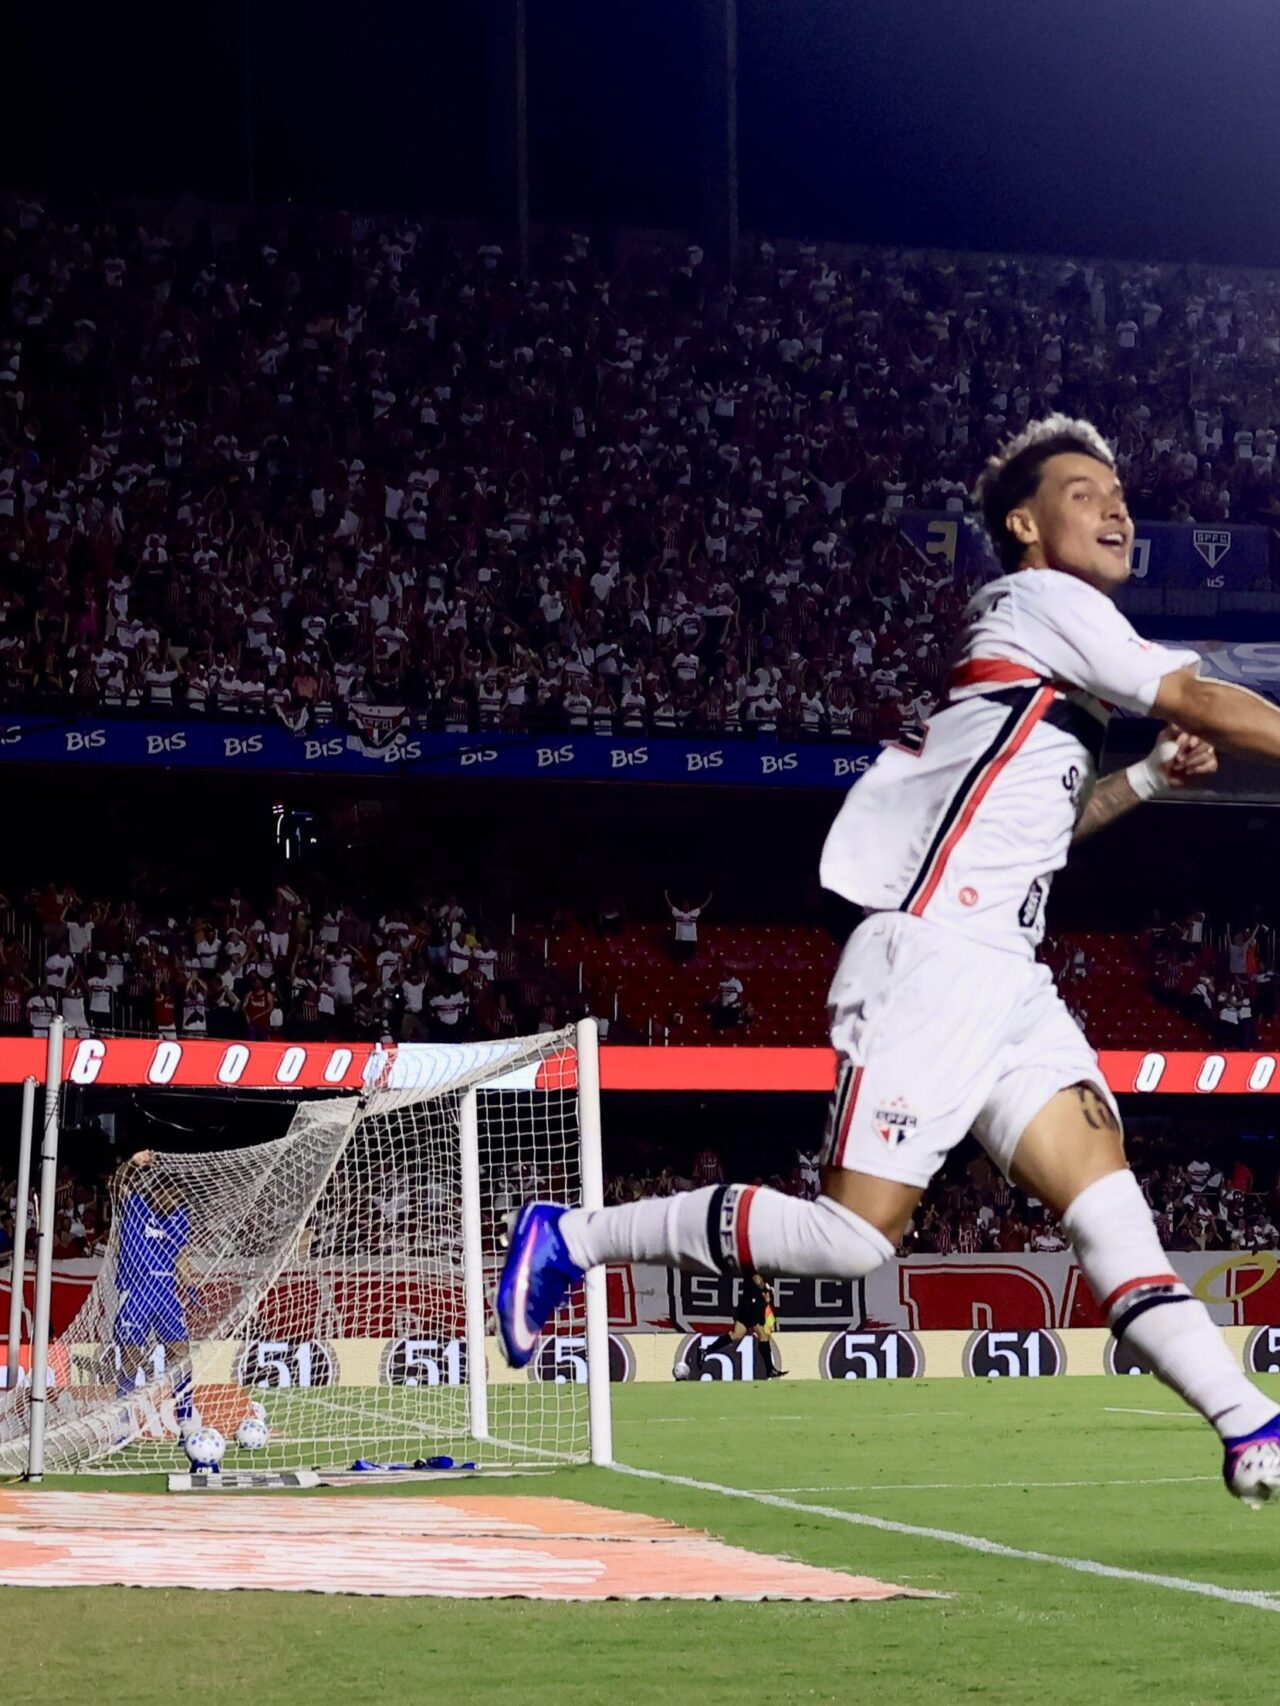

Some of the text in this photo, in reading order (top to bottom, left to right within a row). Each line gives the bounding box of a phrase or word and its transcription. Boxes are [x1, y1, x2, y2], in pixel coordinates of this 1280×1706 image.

[258, 1341, 312, 1387] 51
[406, 1339, 461, 1386] 51
[700, 1335, 755, 1381] 51
[845, 1333, 898, 1379] 51
[988, 1331, 1040, 1377] 51
